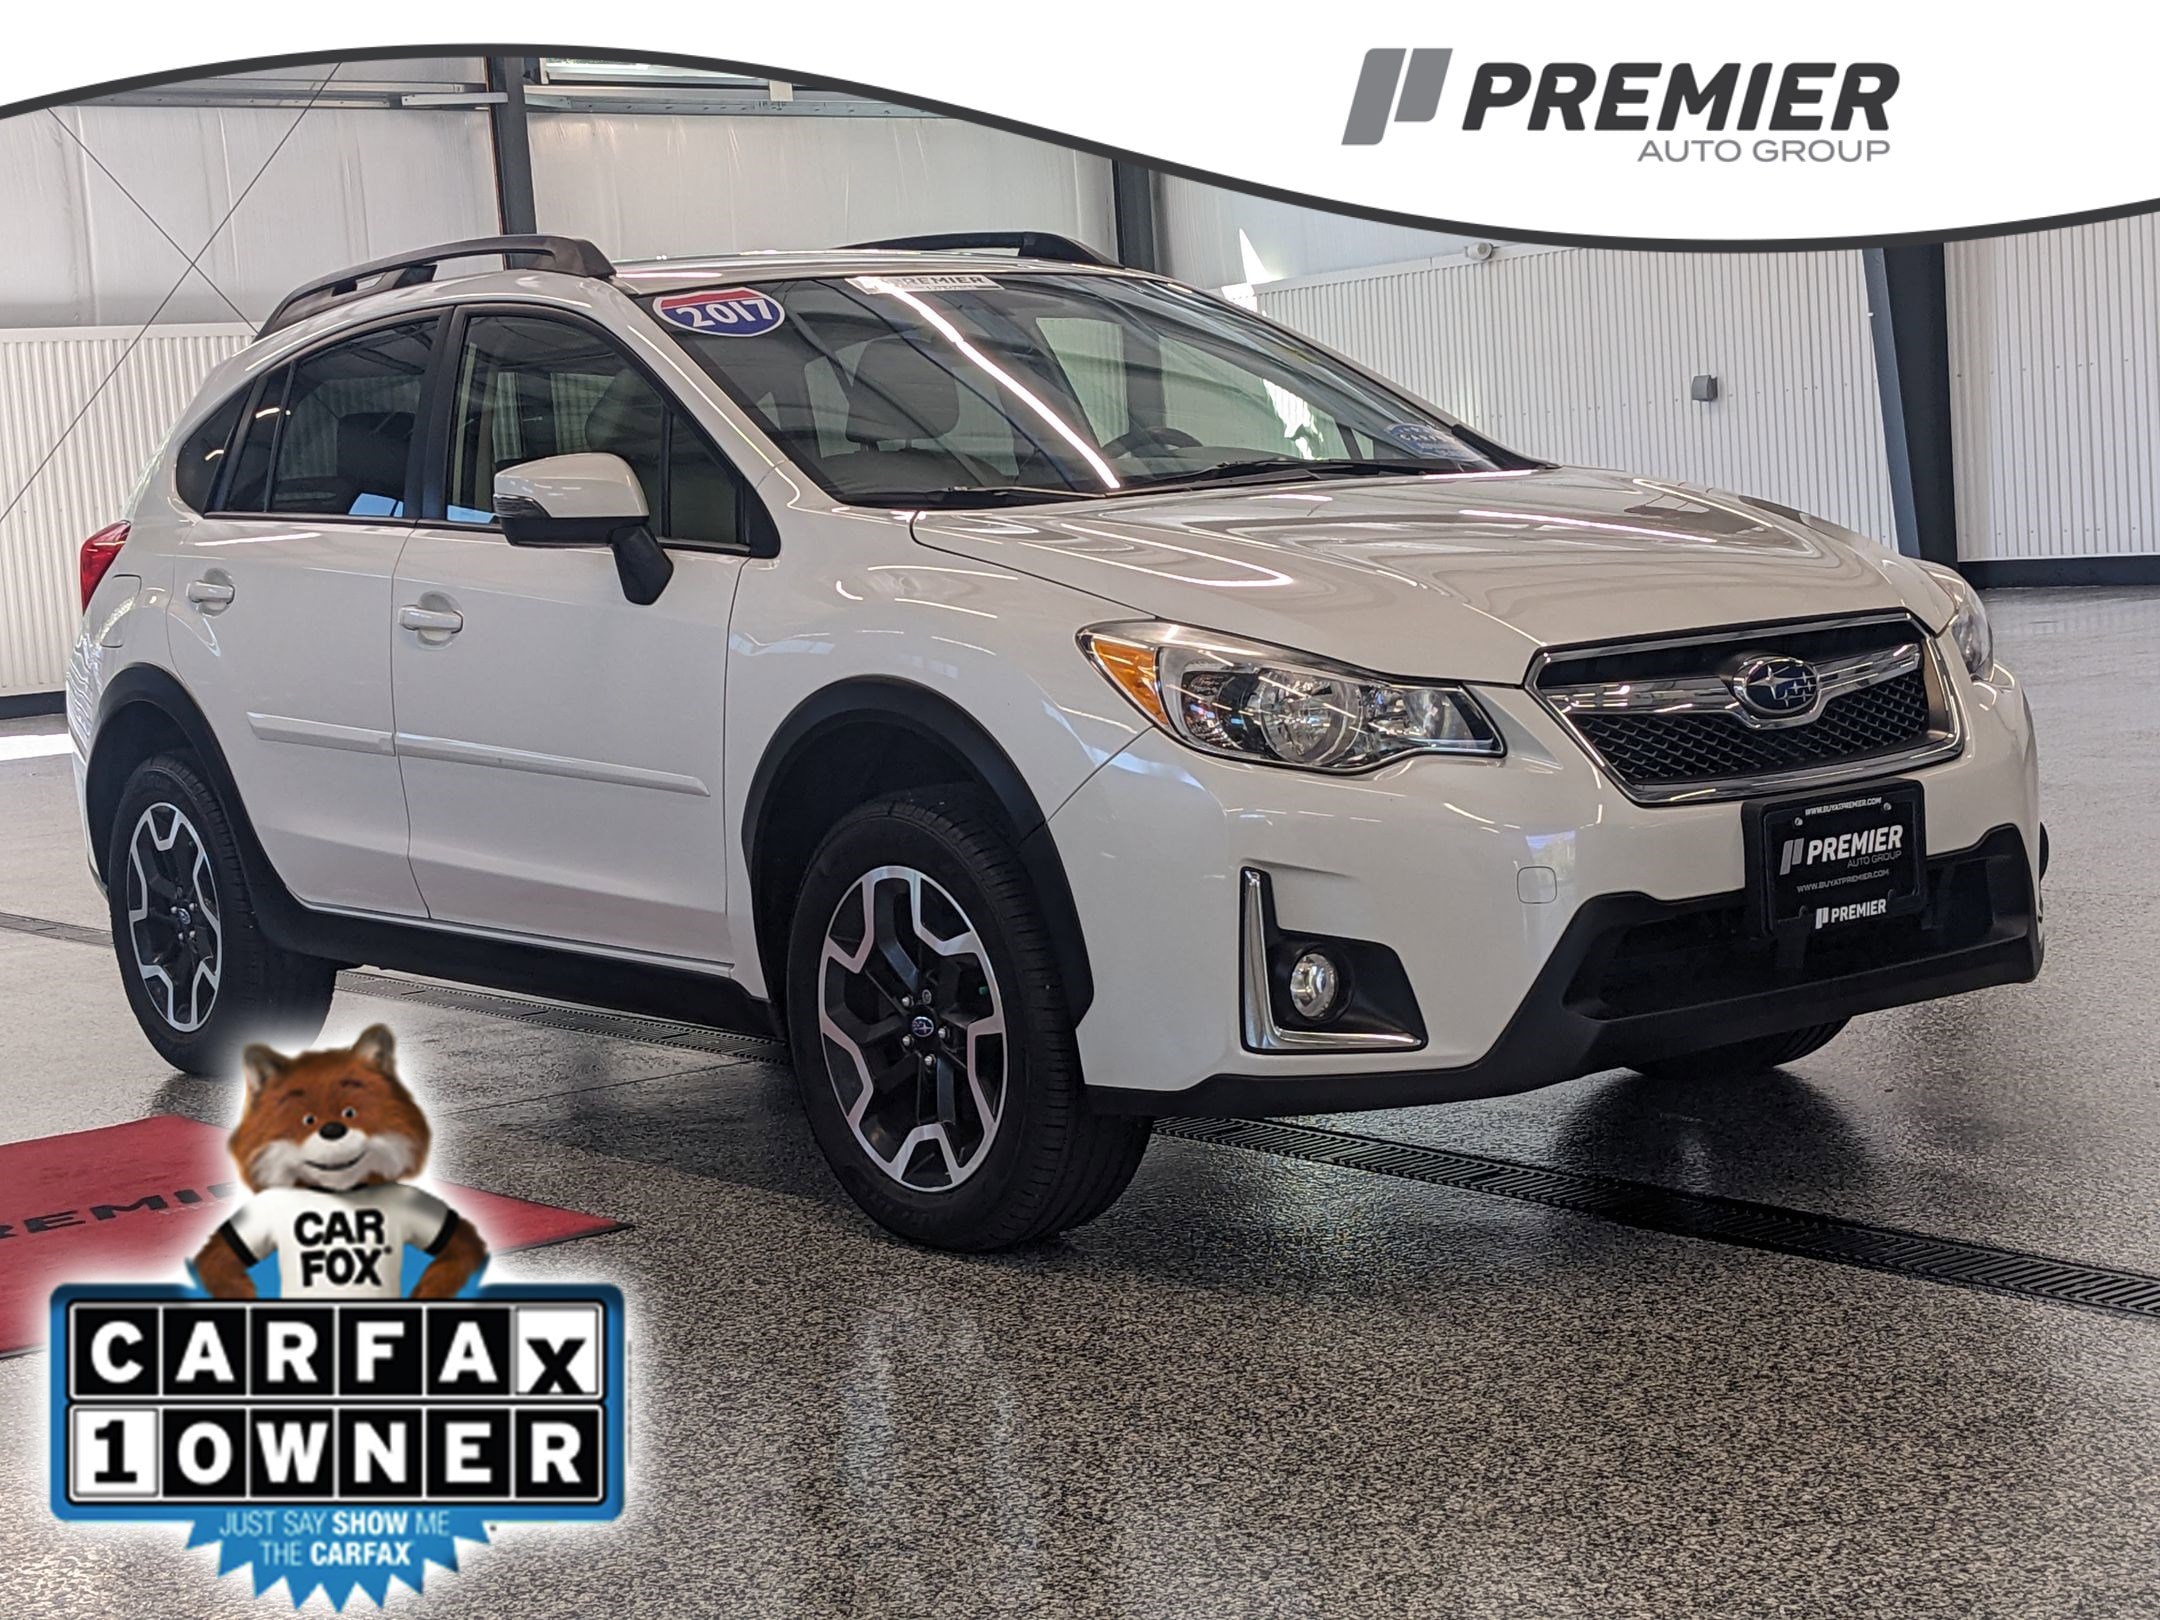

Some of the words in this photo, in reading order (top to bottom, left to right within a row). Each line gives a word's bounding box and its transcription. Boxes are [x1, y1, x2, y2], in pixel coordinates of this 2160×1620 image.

[677, 299, 775, 328] 2017
[1807, 825, 1903, 865] PREMIER
[1847, 855, 1870, 868] AUTO
[1871, 850, 1902, 864] GROUP
[1796, 868, 1890, 893] WWW.BUYATPREMIER.COM
[1831, 899, 1887, 923] PREMIER
